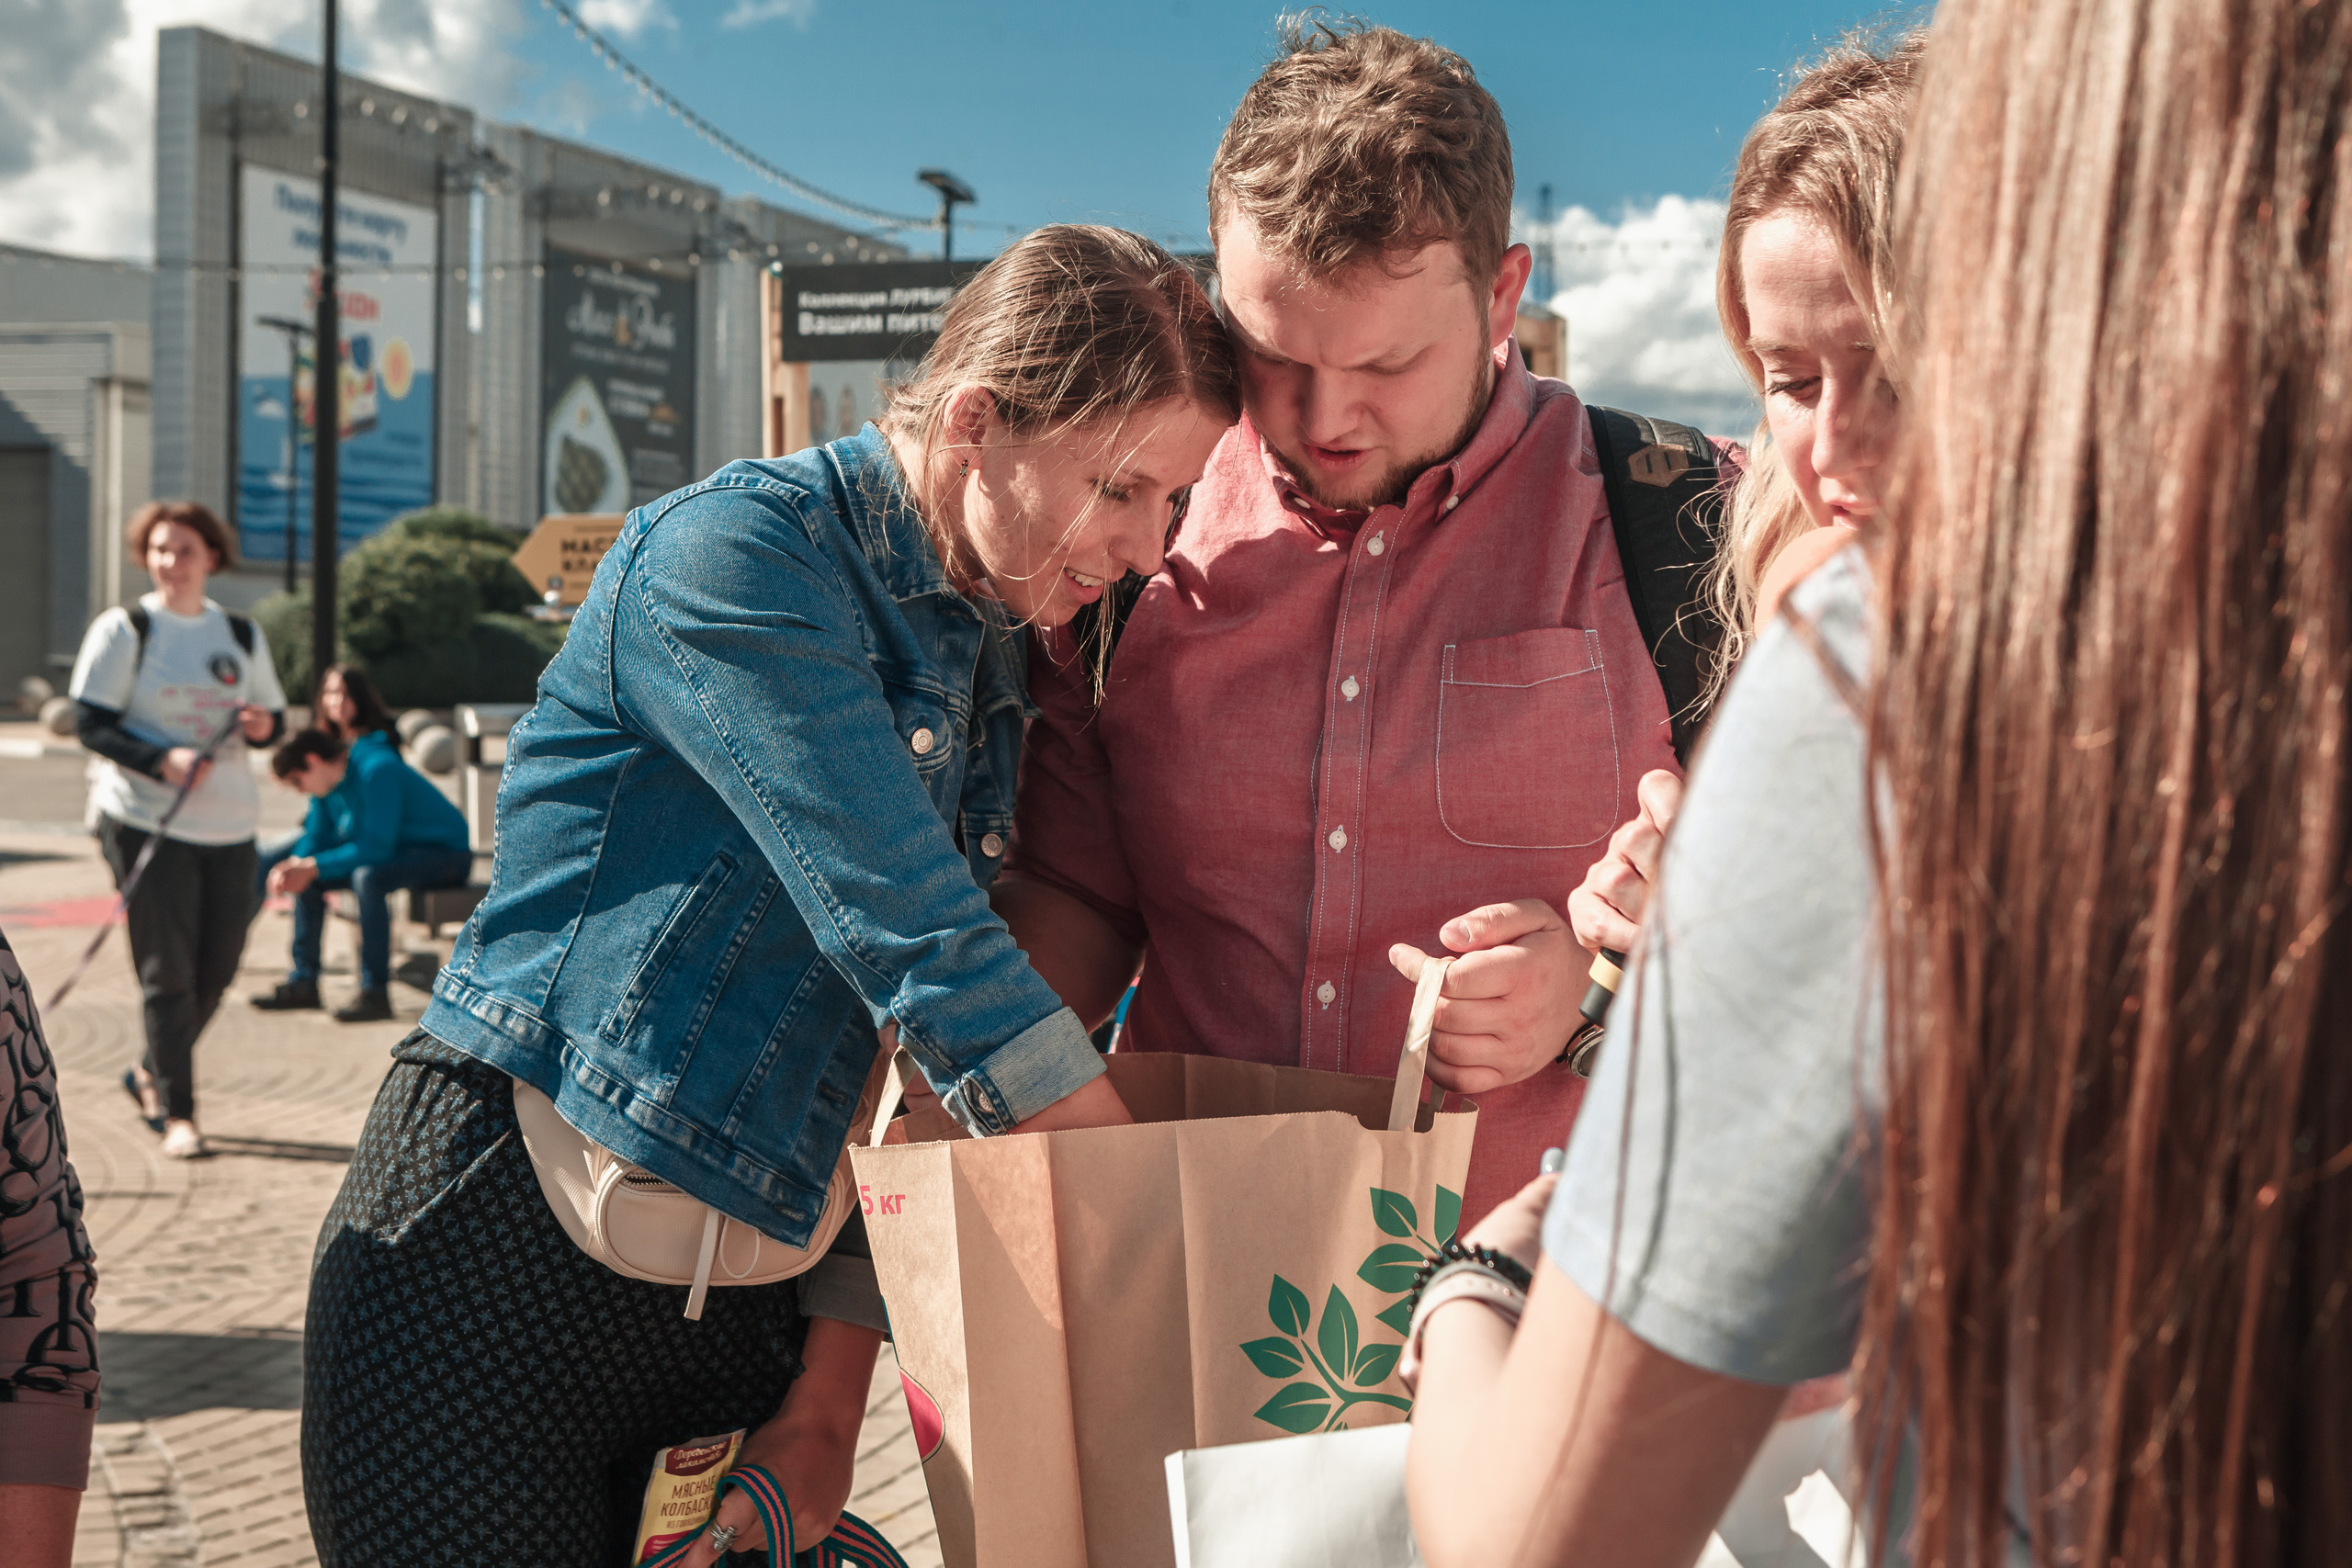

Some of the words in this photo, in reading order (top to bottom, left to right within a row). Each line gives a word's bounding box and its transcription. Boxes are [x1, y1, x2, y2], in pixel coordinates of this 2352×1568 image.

[797, 311, 884, 335] Вашим
[887, 312, 945, 334] пито
[671, 1474, 716, 1499] МЯСНЫЕ
